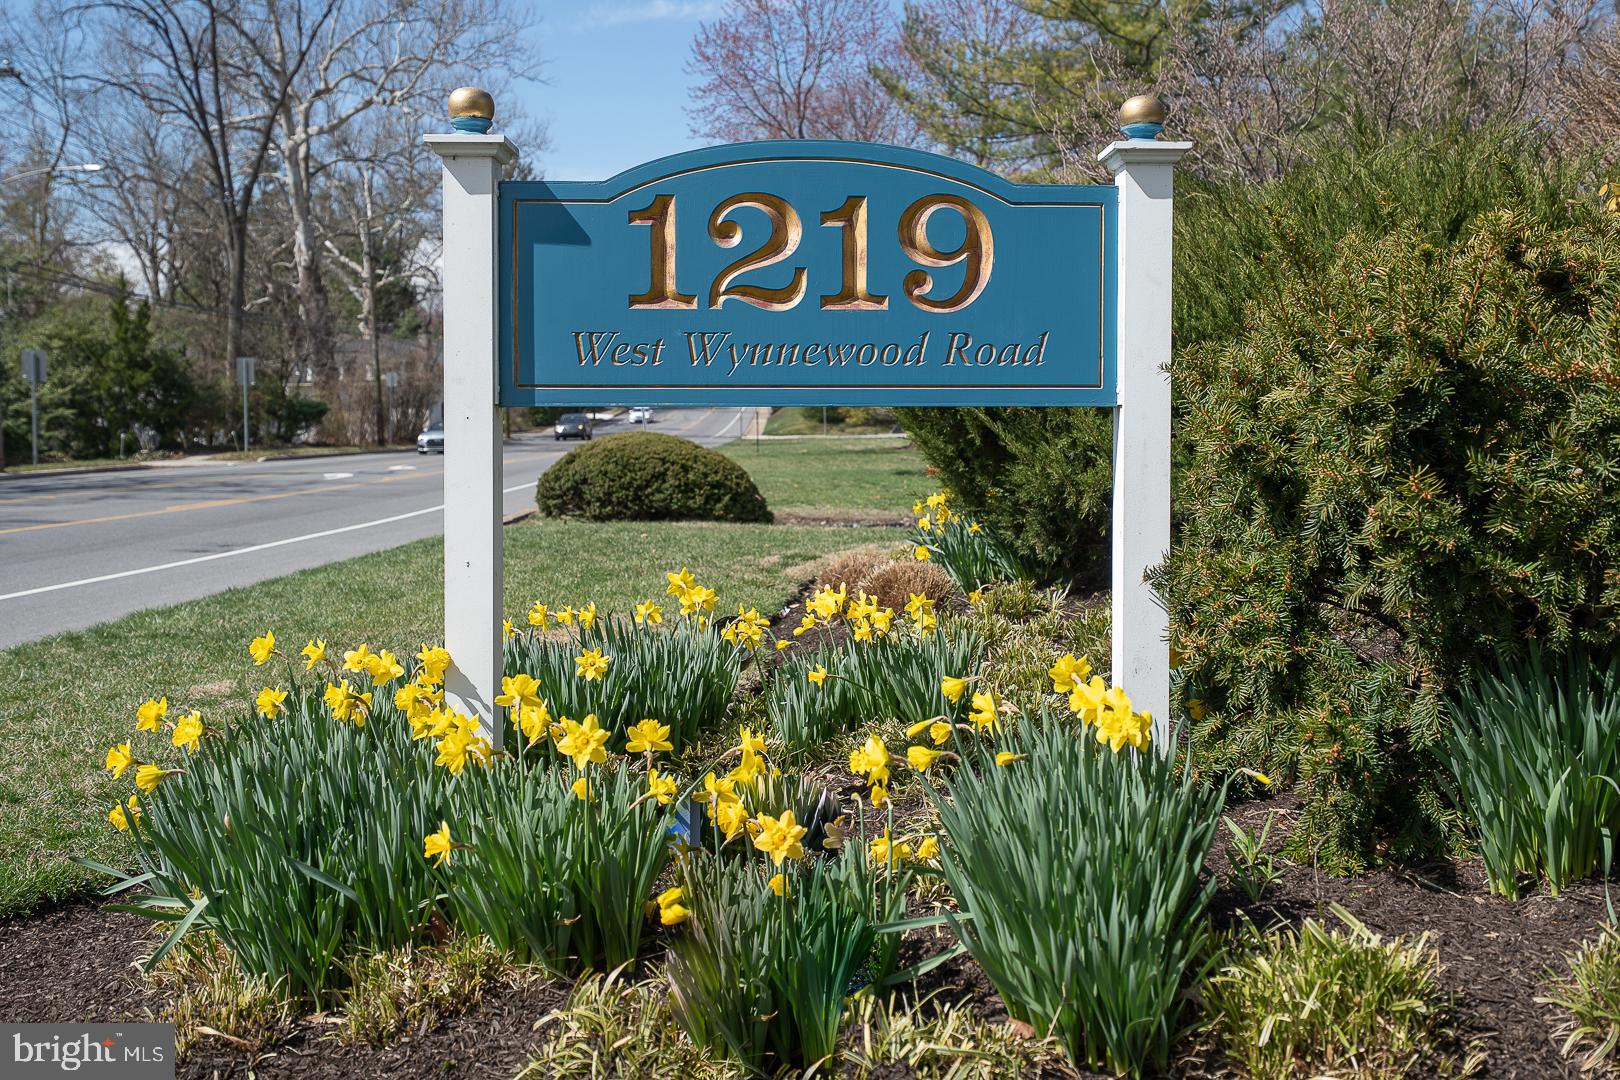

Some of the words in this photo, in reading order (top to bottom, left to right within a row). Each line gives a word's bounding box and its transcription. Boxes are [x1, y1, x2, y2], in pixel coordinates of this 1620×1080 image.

[628, 193, 995, 313] 1219
[571, 331, 666, 367] West
[683, 331, 931, 377] Wynnewood
[942, 331, 1049, 367] Road
